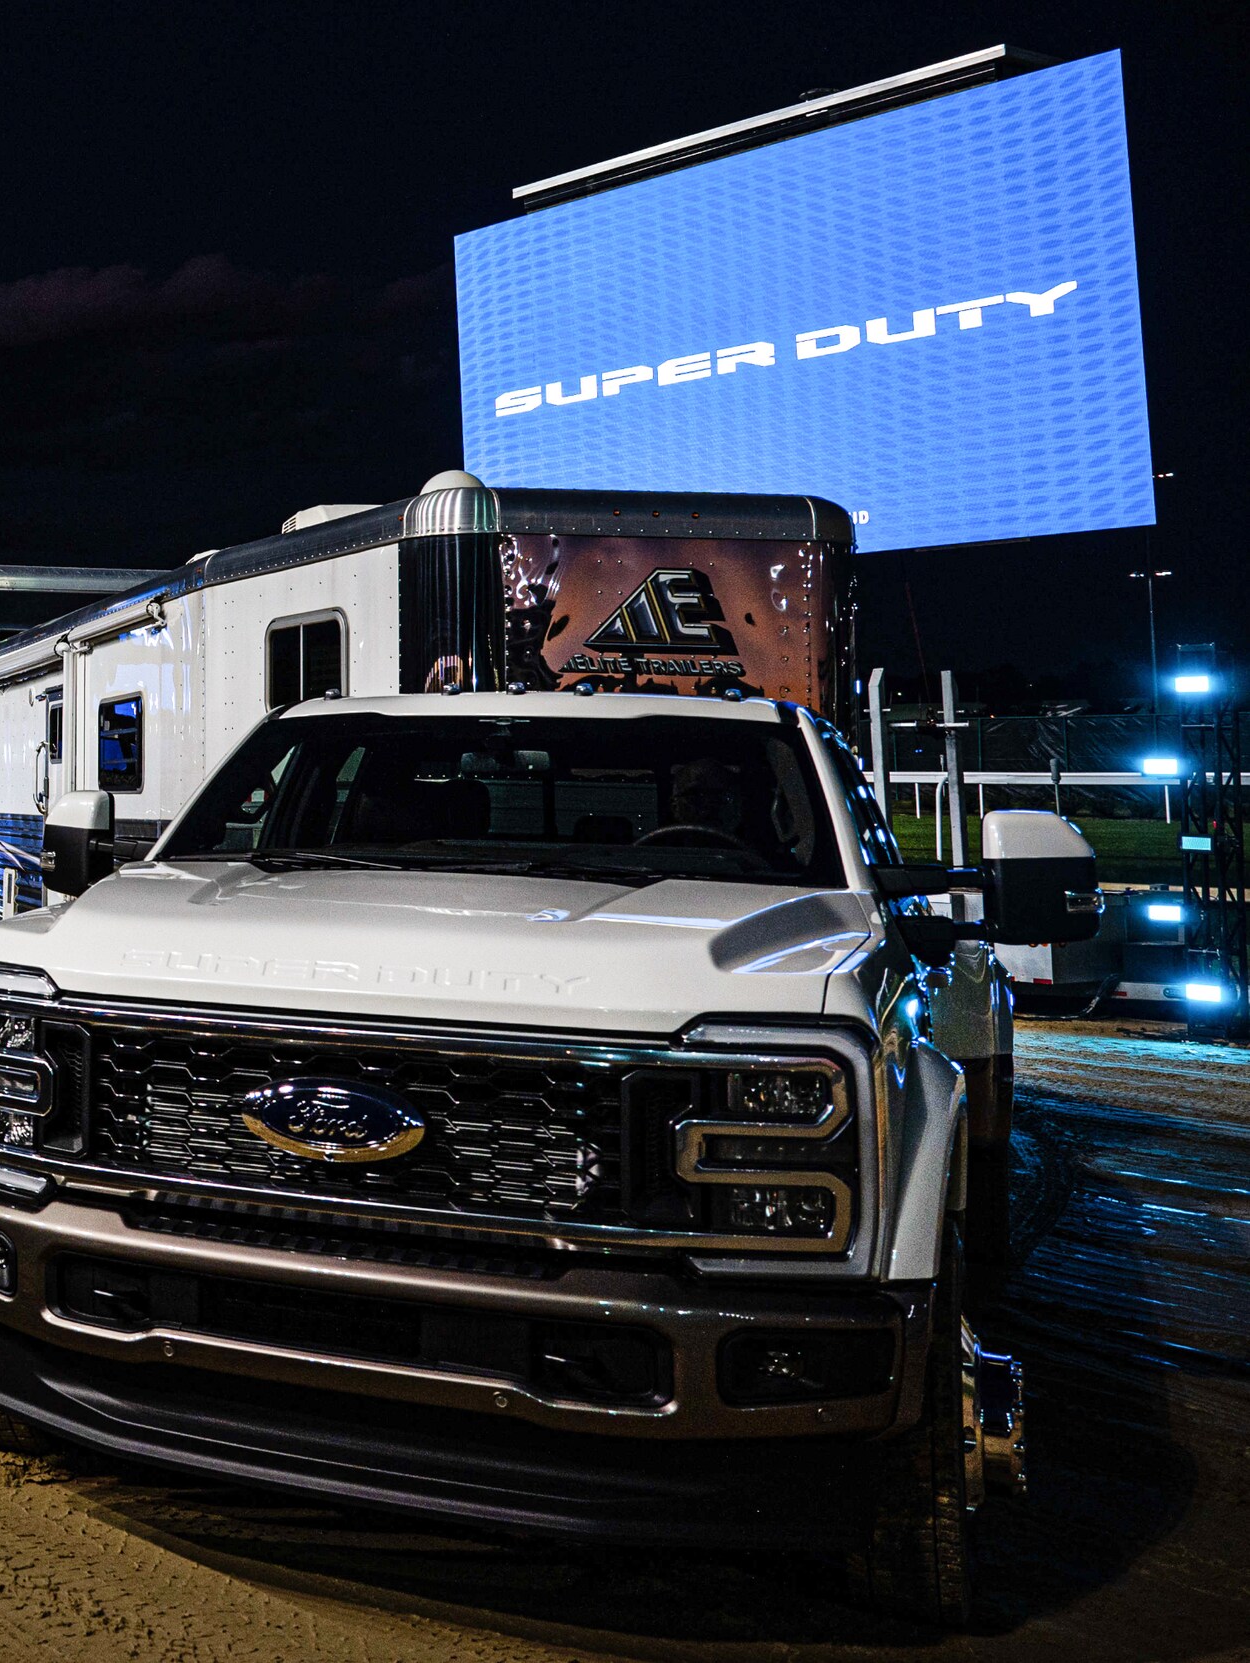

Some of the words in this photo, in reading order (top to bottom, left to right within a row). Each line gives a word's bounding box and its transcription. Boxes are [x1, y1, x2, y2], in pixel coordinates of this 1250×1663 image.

[496, 342, 774, 416] SUPER
[797, 282, 1076, 359] DUTY
[634, 657, 743, 676] TRAILERS
[119, 948, 359, 982] SUPER
[376, 964, 591, 996] DUTY
[287, 1100, 370, 1138] Ford
